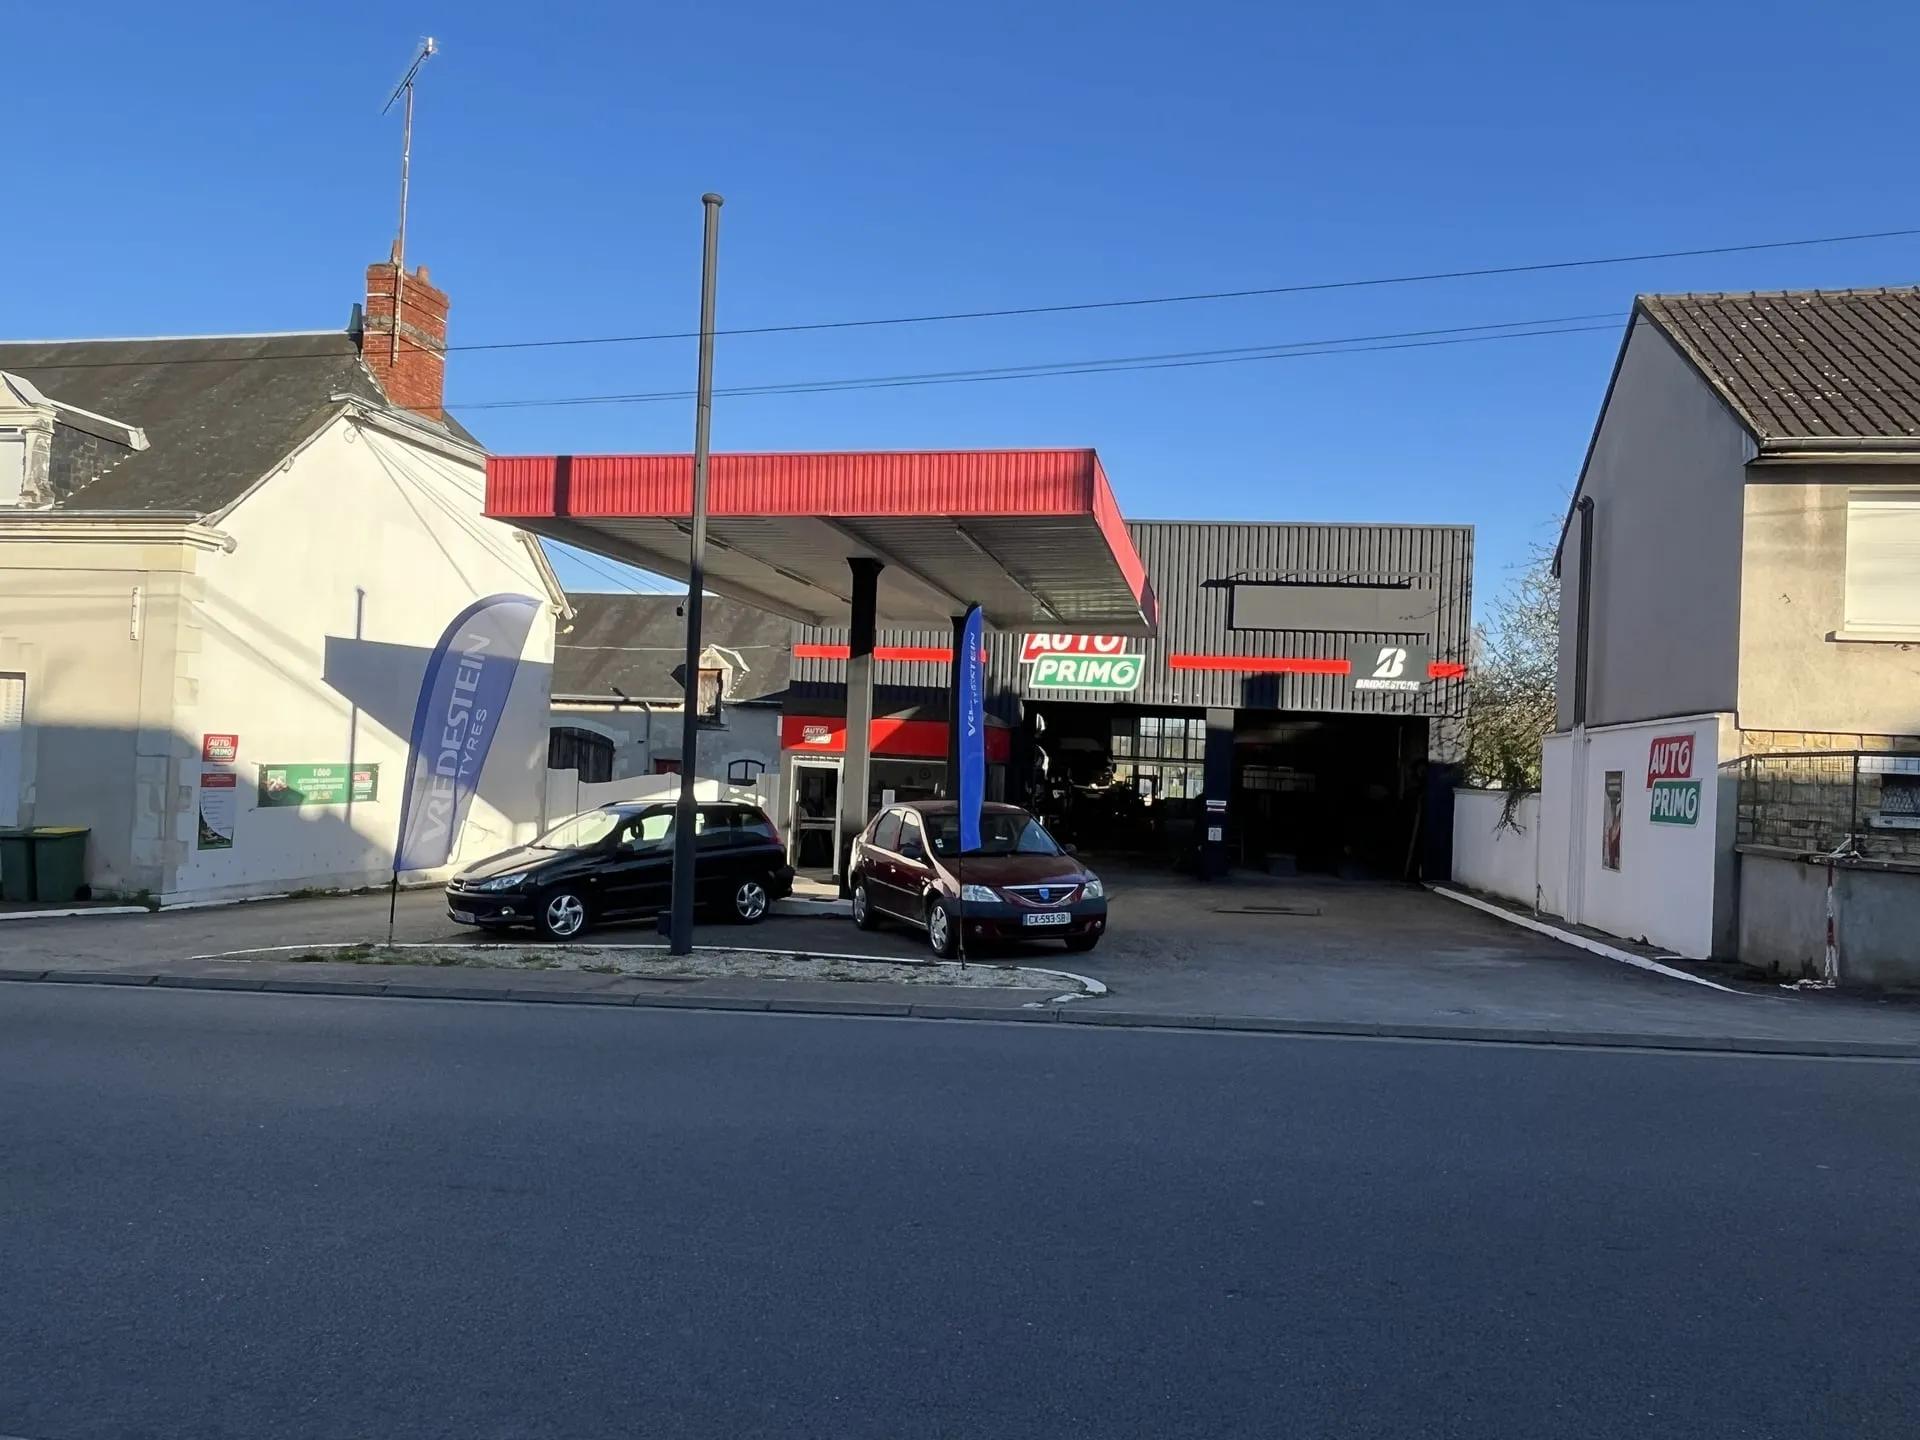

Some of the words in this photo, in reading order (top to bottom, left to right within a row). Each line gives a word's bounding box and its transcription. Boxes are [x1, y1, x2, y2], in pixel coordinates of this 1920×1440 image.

[1028, 633, 1121, 652] AUTO
[1037, 659, 1136, 685] PRIMO
[208, 738, 230, 747] AUTO
[209, 747, 233, 756] PRIMO
[421, 633, 491, 843] VREDESTEIN
[458, 708, 488, 779] TYRES
[1650, 740, 1691, 775] AUTO
[1652, 787, 1698, 819] PRIMO
